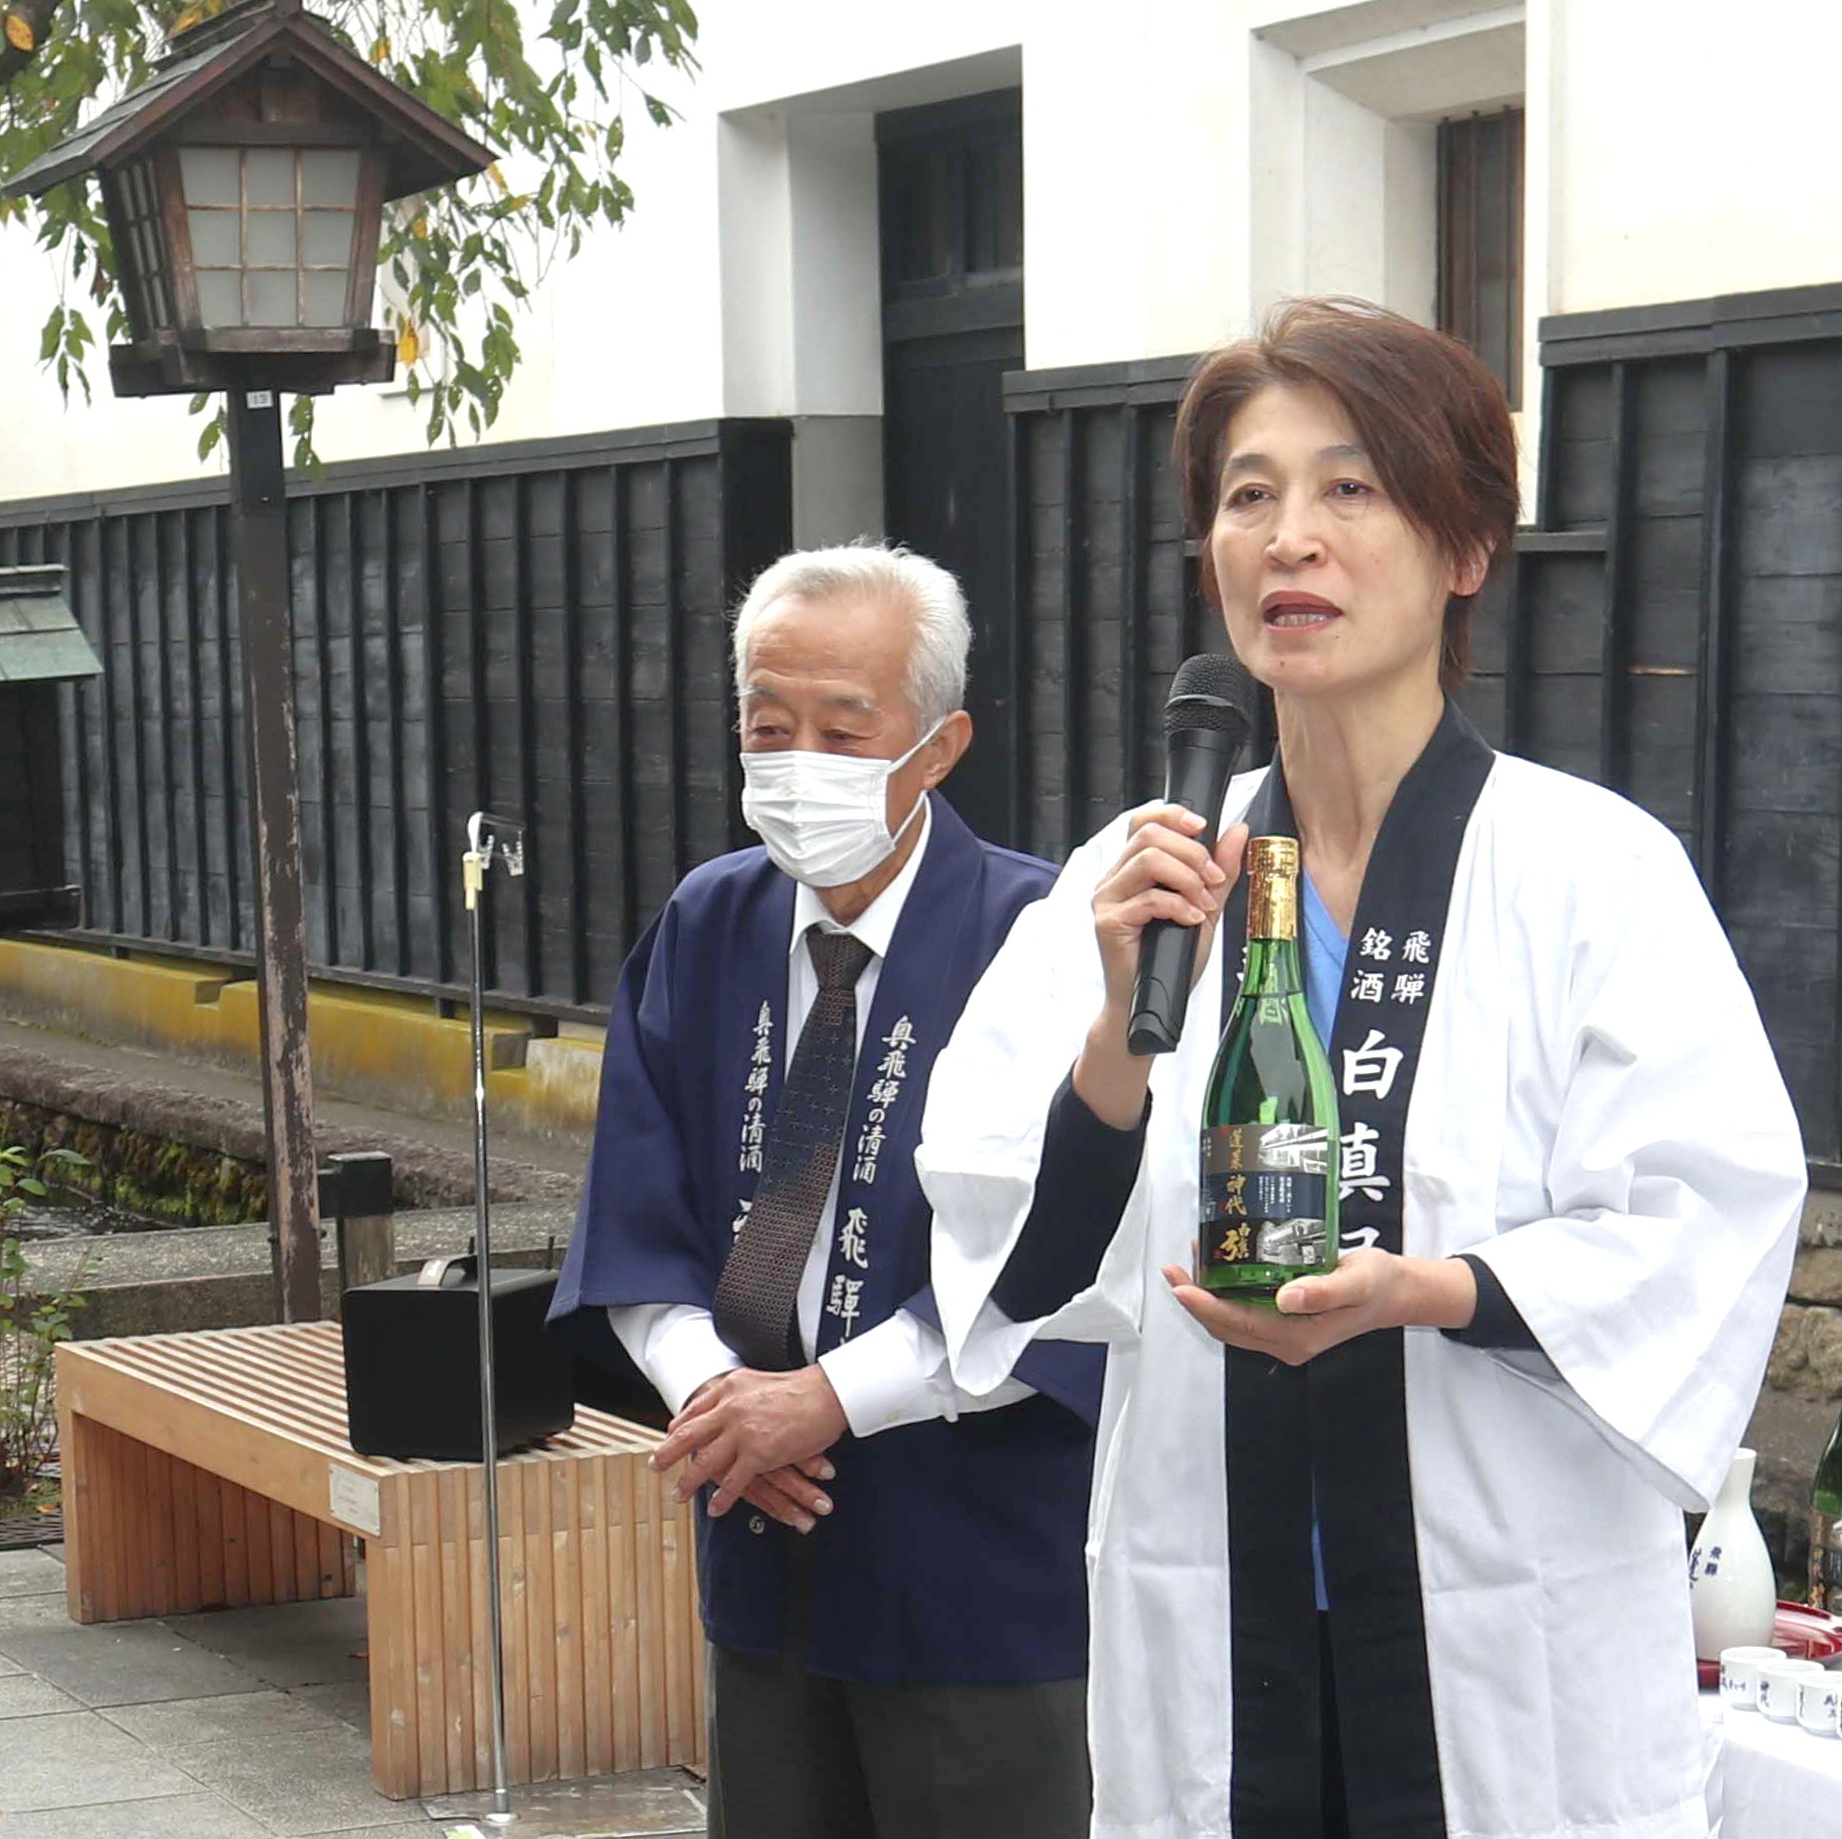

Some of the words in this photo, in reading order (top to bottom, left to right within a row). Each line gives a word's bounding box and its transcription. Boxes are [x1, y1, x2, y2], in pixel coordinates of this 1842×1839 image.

[1350, 926, 1394, 1004] 銘酒
[1390, 930, 1432, 1005] 飛騨
[1224, 1173, 1248, 1216] 神代
[825, 1207, 869, 1346] 飛騨
